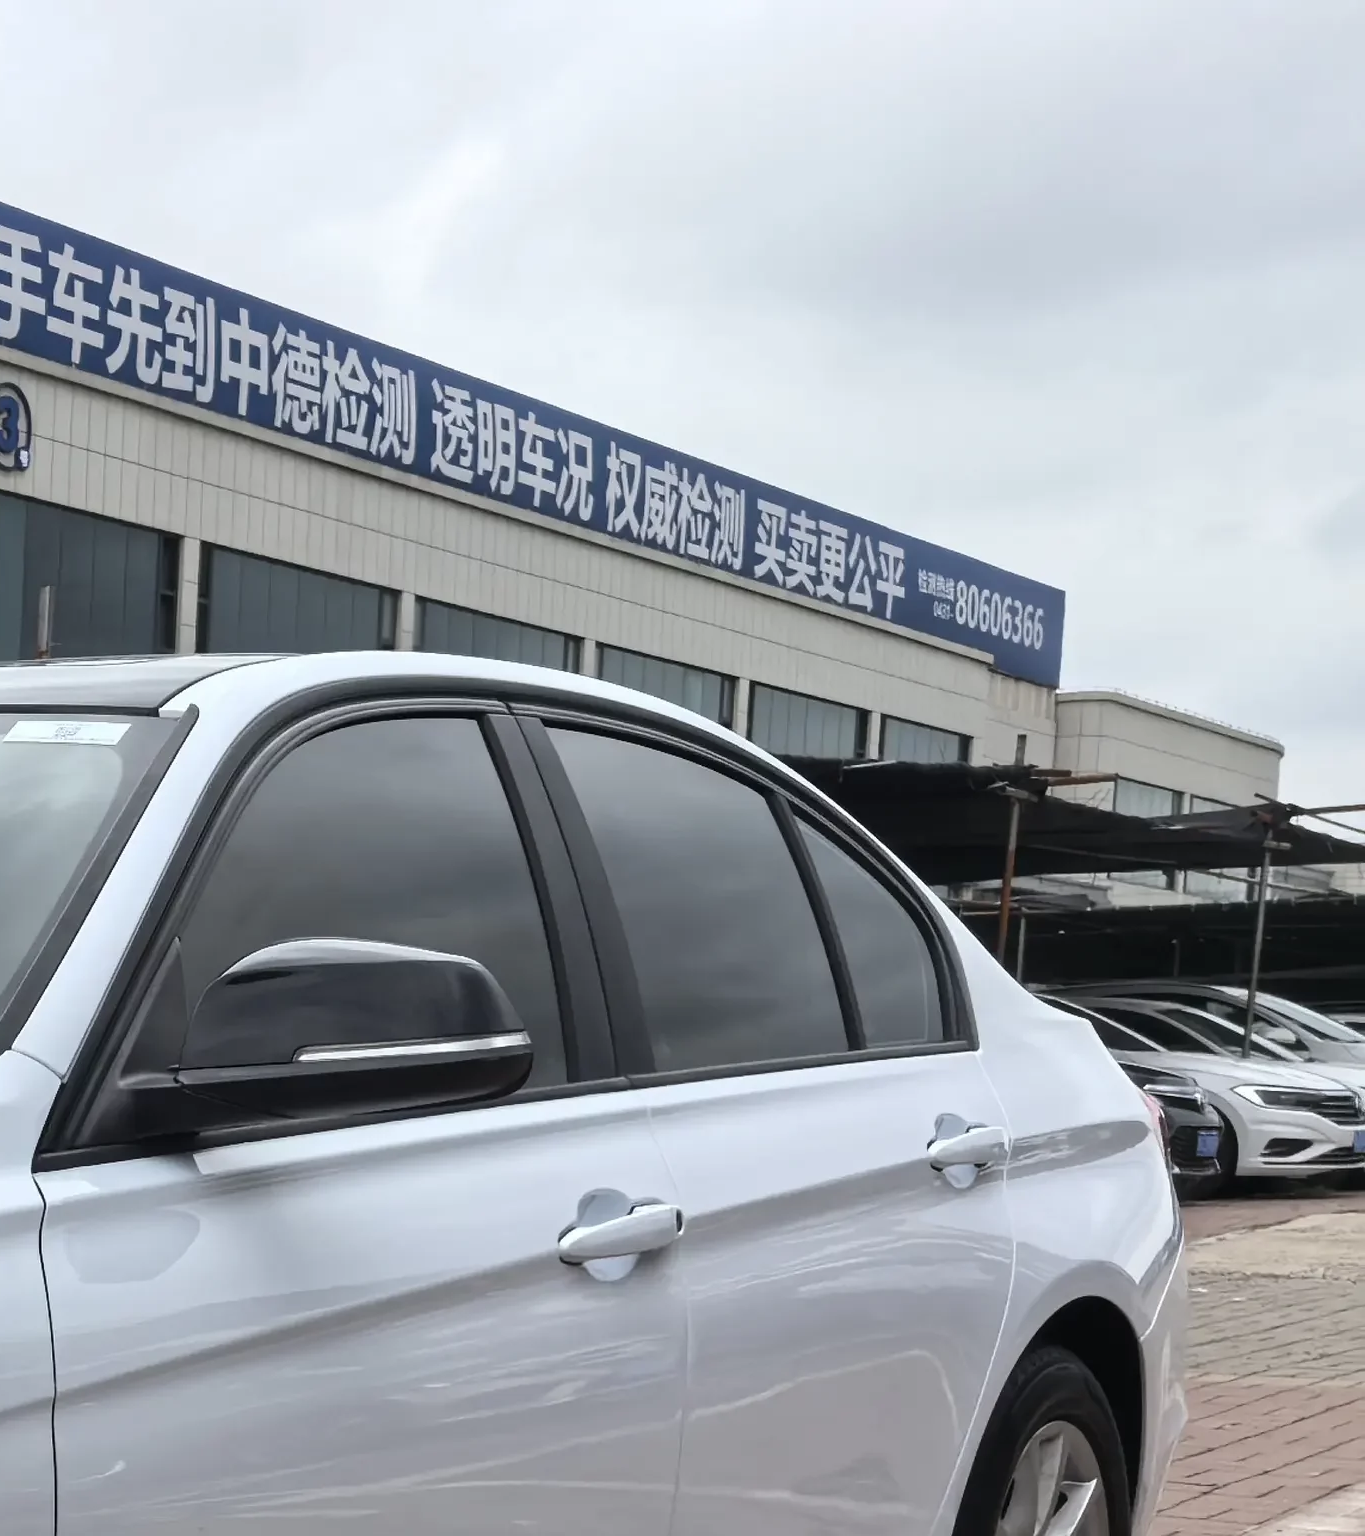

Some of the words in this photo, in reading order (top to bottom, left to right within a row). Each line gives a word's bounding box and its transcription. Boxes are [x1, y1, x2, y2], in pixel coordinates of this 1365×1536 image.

[430, 378, 593, 521] 透明车况
[606, 441, 745, 570] 权威检测
[754, 498, 905, 620] 买卖更公平
[955, 580, 1044, 650] 80606366
